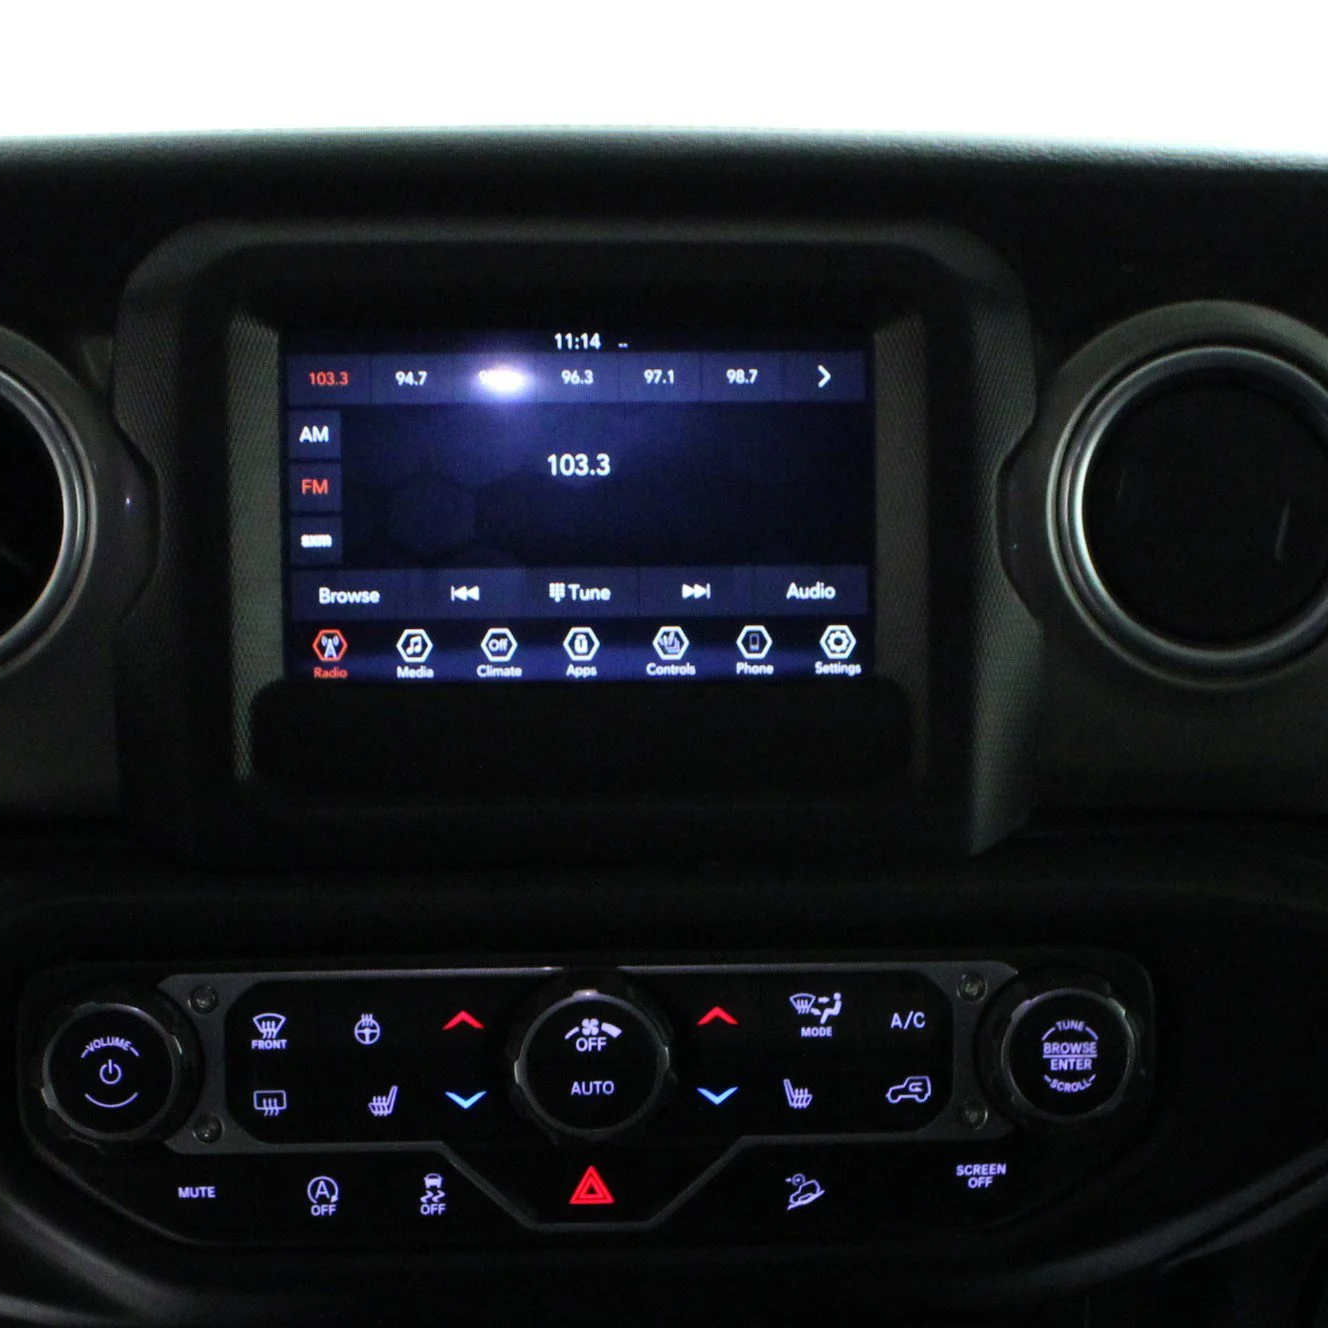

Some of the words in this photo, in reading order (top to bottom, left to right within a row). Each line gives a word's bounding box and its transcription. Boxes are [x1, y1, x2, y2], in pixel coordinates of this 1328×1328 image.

[554, 332, 601, 350] 11:14
[308, 370, 349, 387] 103.3
[395, 369, 428, 386] 94.7
[560, 368, 594, 385] 96.3
[643, 368, 675, 385] 97.1
[726, 368, 759, 385] 98.7
[299, 425, 330, 444] AM
[547, 453, 611, 477] 103.3
[301, 479, 329, 496] FM
[318, 586, 381, 604] Browse
[567, 583, 612, 602] Tune
[785, 581, 836, 600] Audio
[313, 666, 348, 680] Radio
[396, 665, 434, 680] Media
[476, 663, 523, 678] Climate
[565, 663, 598, 680] Apps
[645, 661, 696, 677] Controls
[735, 661, 775, 676] Phone
[814, 660, 862, 678] Settings
[890, 1010, 926, 1030] A/C
[1055, 1019, 1087, 1034] TUNE
[801, 1026, 833, 1038] MODE
[86, 1036, 132, 1055] VOLUME
[251, 1038, 287, 1050] FRONT
[575, 1036, 608, 1053] OFF
[1042, 1040, 1098, 1056] BROWSE
[1050, 1057, 1092, 1071] ENTER
[571, 1080, 615, 1096] AUTO
[1049, 1076, 1092, 1093] SCROLL
[955, 1162, 1007, 1176] SCREEN
[968, 1175, 994, 1189] OFF
[177, 1185, 216, 1199] MUTE
[310, 1203, 337, 1217] OFF
[419, 1202, 447, 1216] OFF
